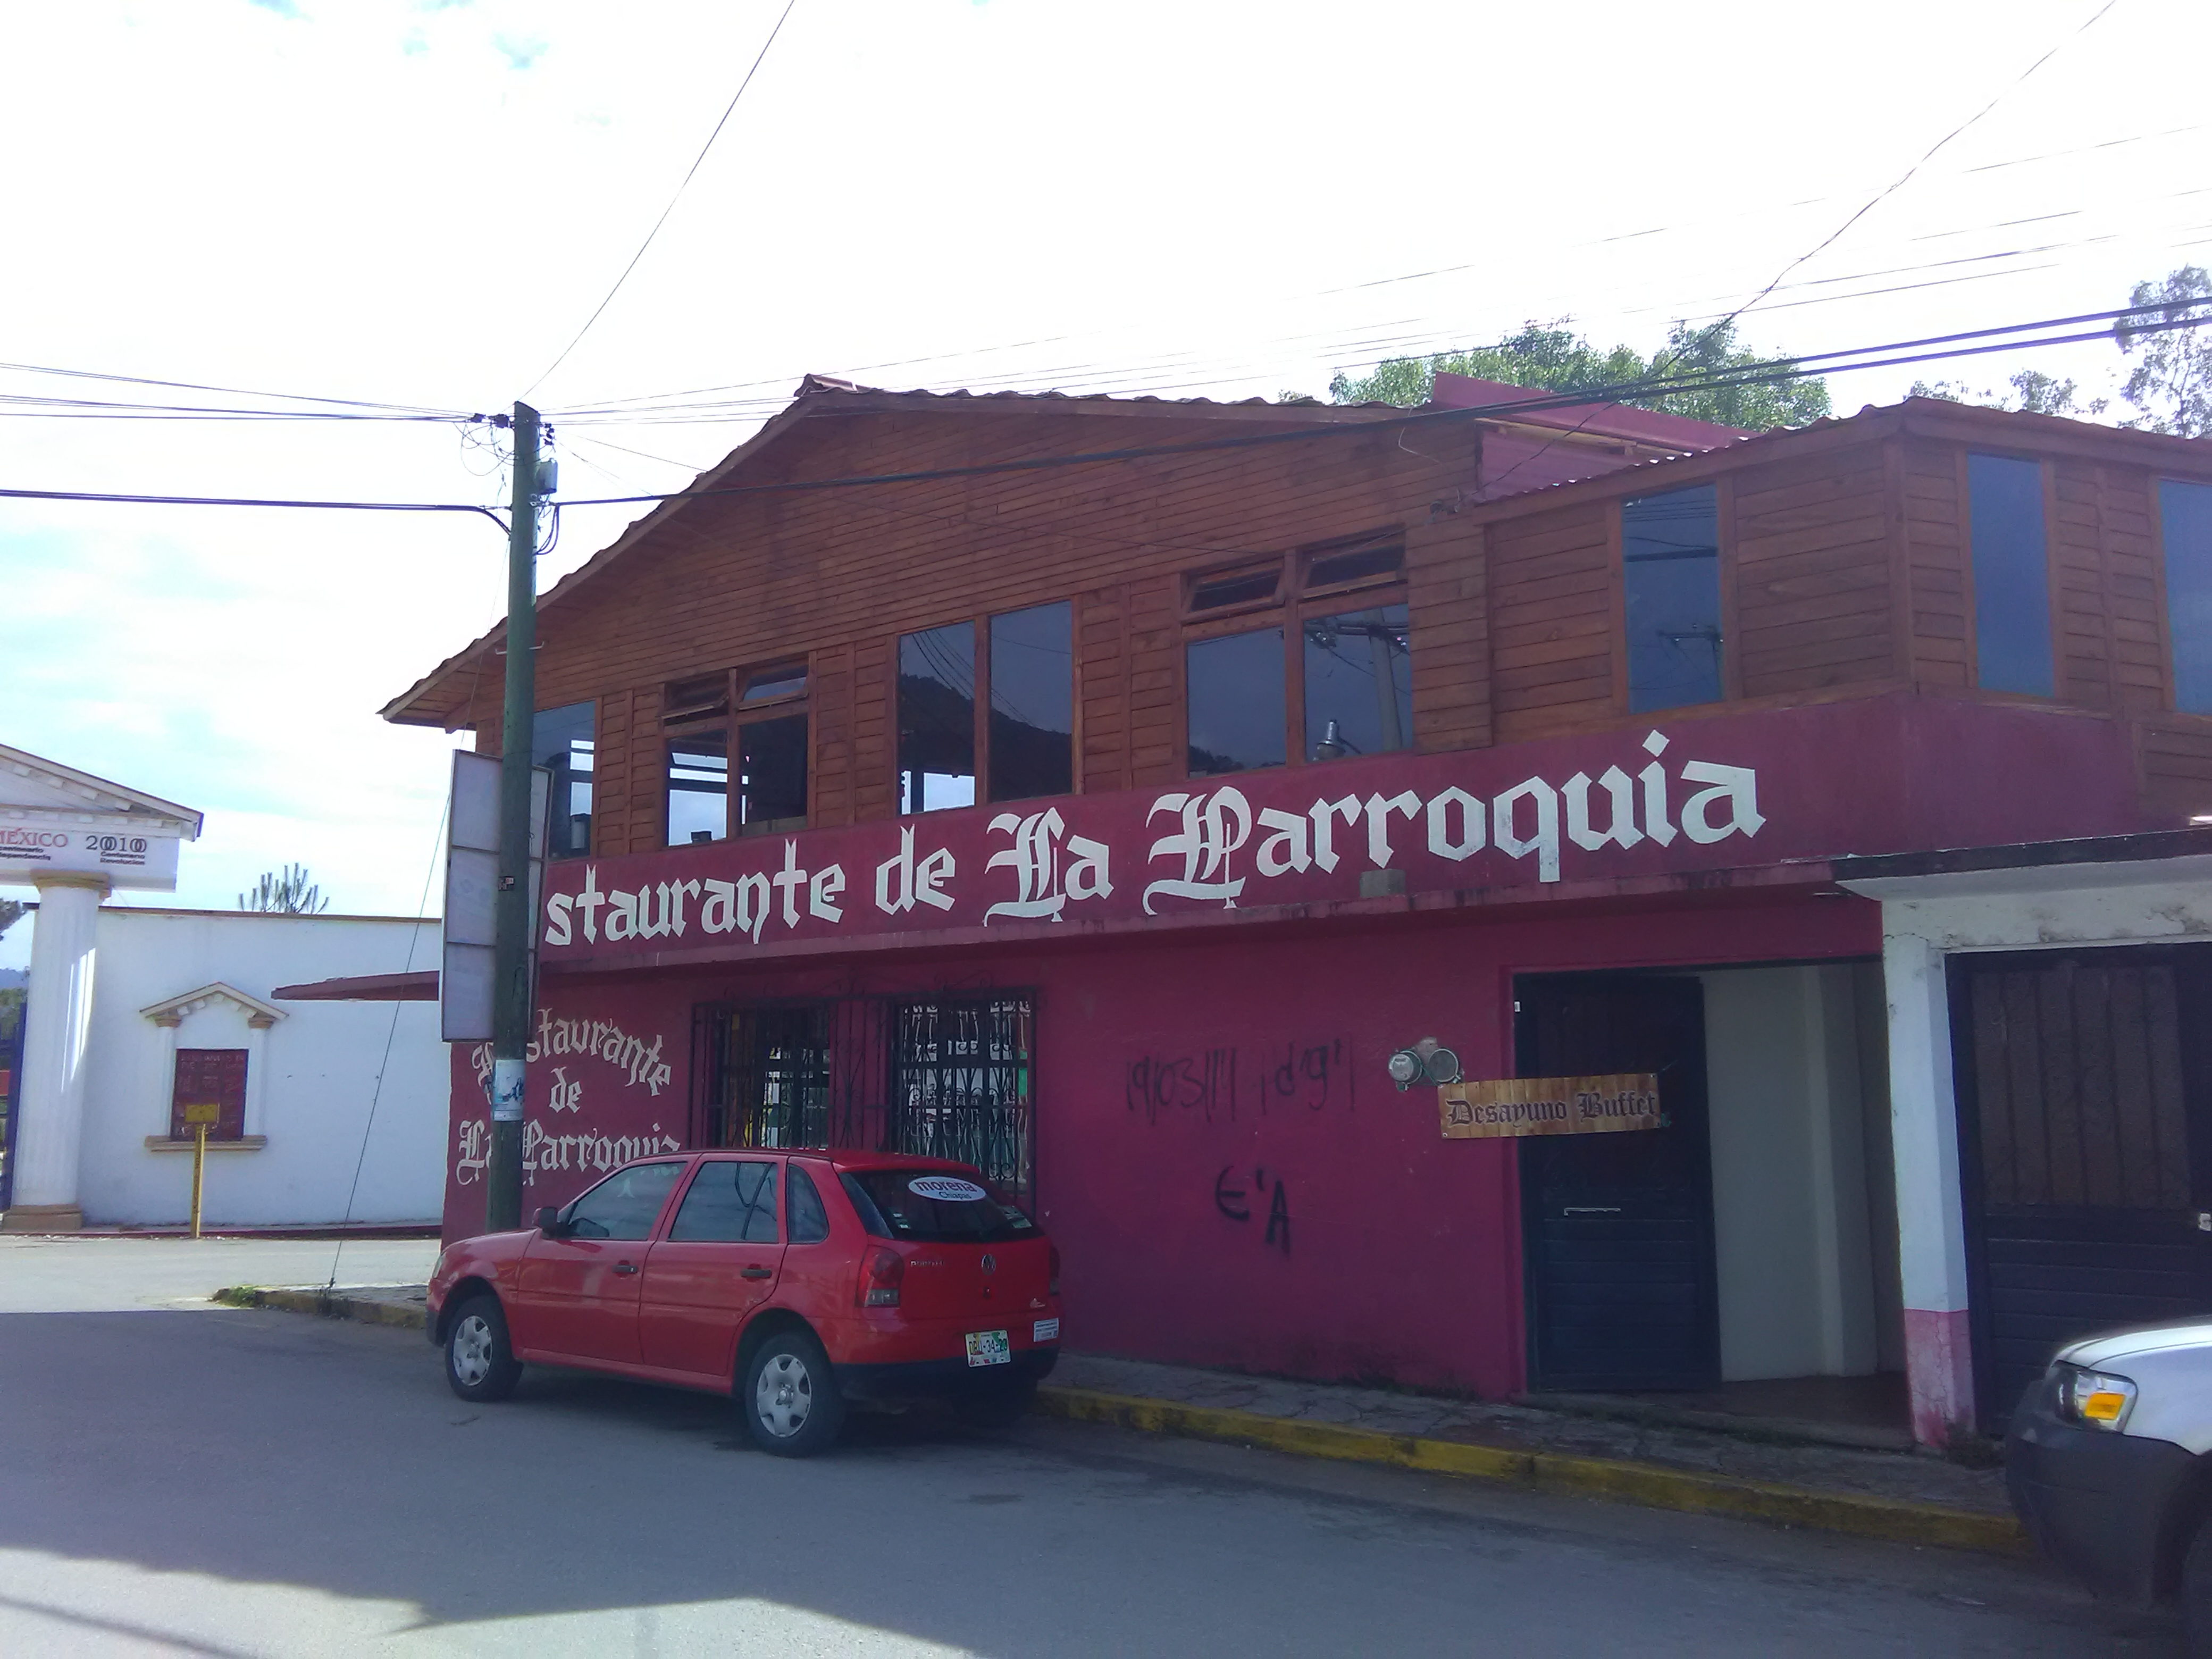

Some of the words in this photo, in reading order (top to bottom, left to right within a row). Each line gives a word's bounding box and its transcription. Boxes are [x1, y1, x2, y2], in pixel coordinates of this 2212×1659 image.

[544, 838, 846, 946] staurante
[875, 824, 956, 916] de
[983, 806, 1114, 927] La
[1142, 729, 1766, 916] Parroquia
[472, 1008, 671, 1105] Rtaurante
[549, 1066, 583, 1113] de
[1446, 1099, 1568, 1128] Desayuno
[1577, 1091, 1656, 1123] Buffet
[456, 1119, 493, 1186] L
[914, 1182, 978, 1193] morena
[939, 1191, 973, 1200] Chiapas
